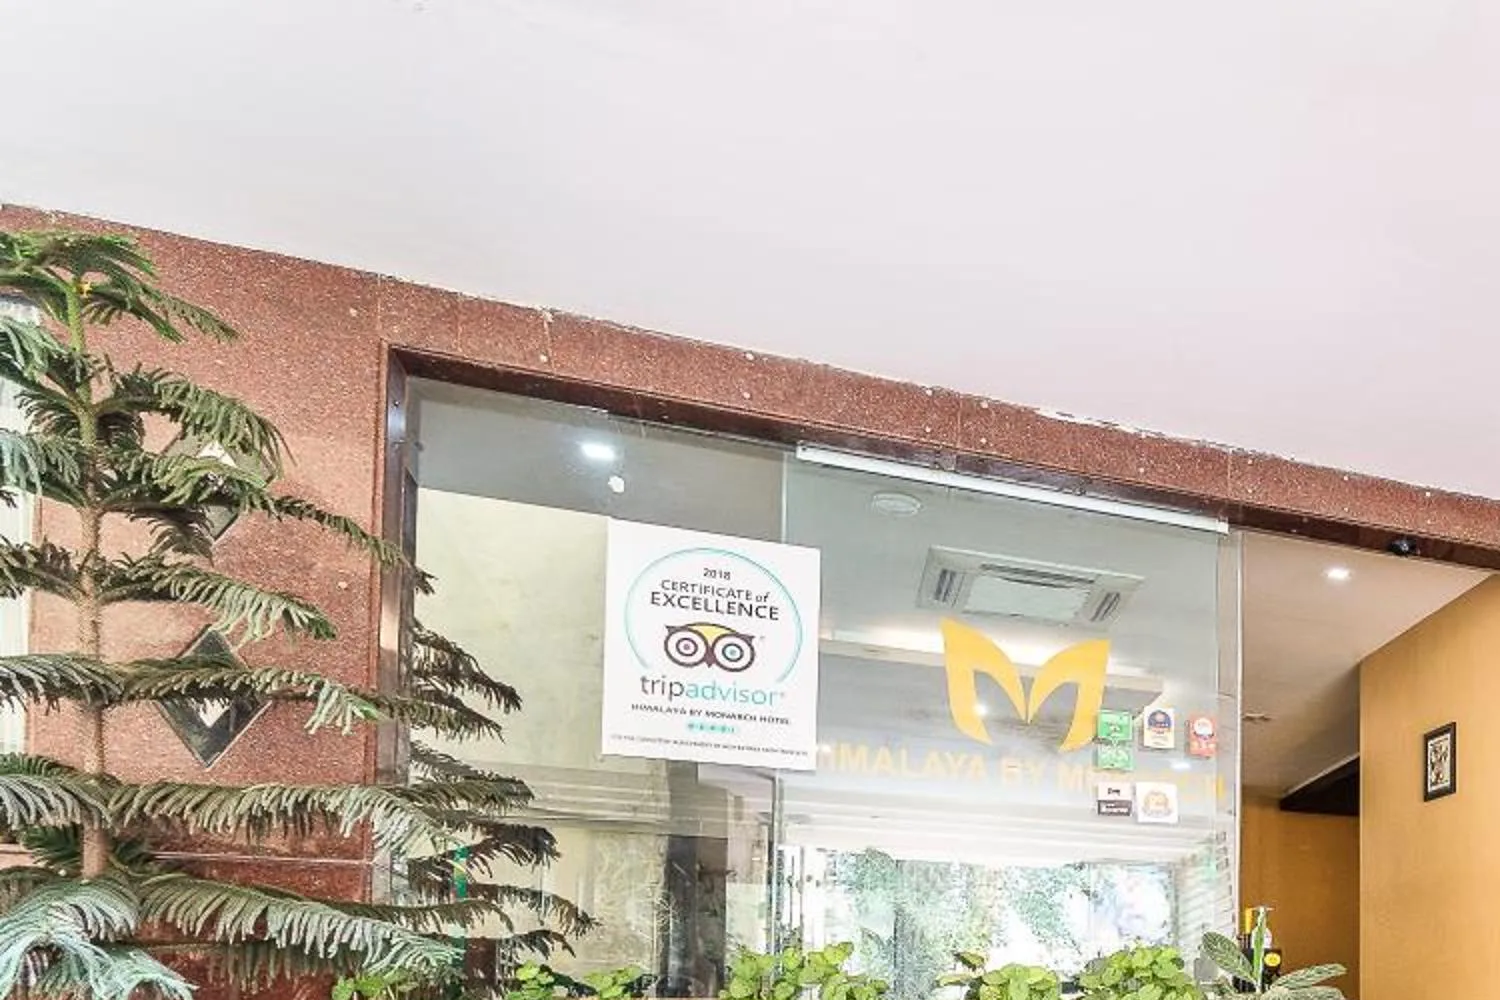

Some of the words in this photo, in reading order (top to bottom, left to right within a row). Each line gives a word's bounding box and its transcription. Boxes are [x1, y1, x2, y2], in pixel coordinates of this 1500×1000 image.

[703, 567, 731, 581] 2018
[660, 579, 753, 601] CERTIFICATE
[755, 592, 770, 603] of
[650, 591, 780, 621] EXCELLENCE
[640, 674, 777, 706] tripadvisor
